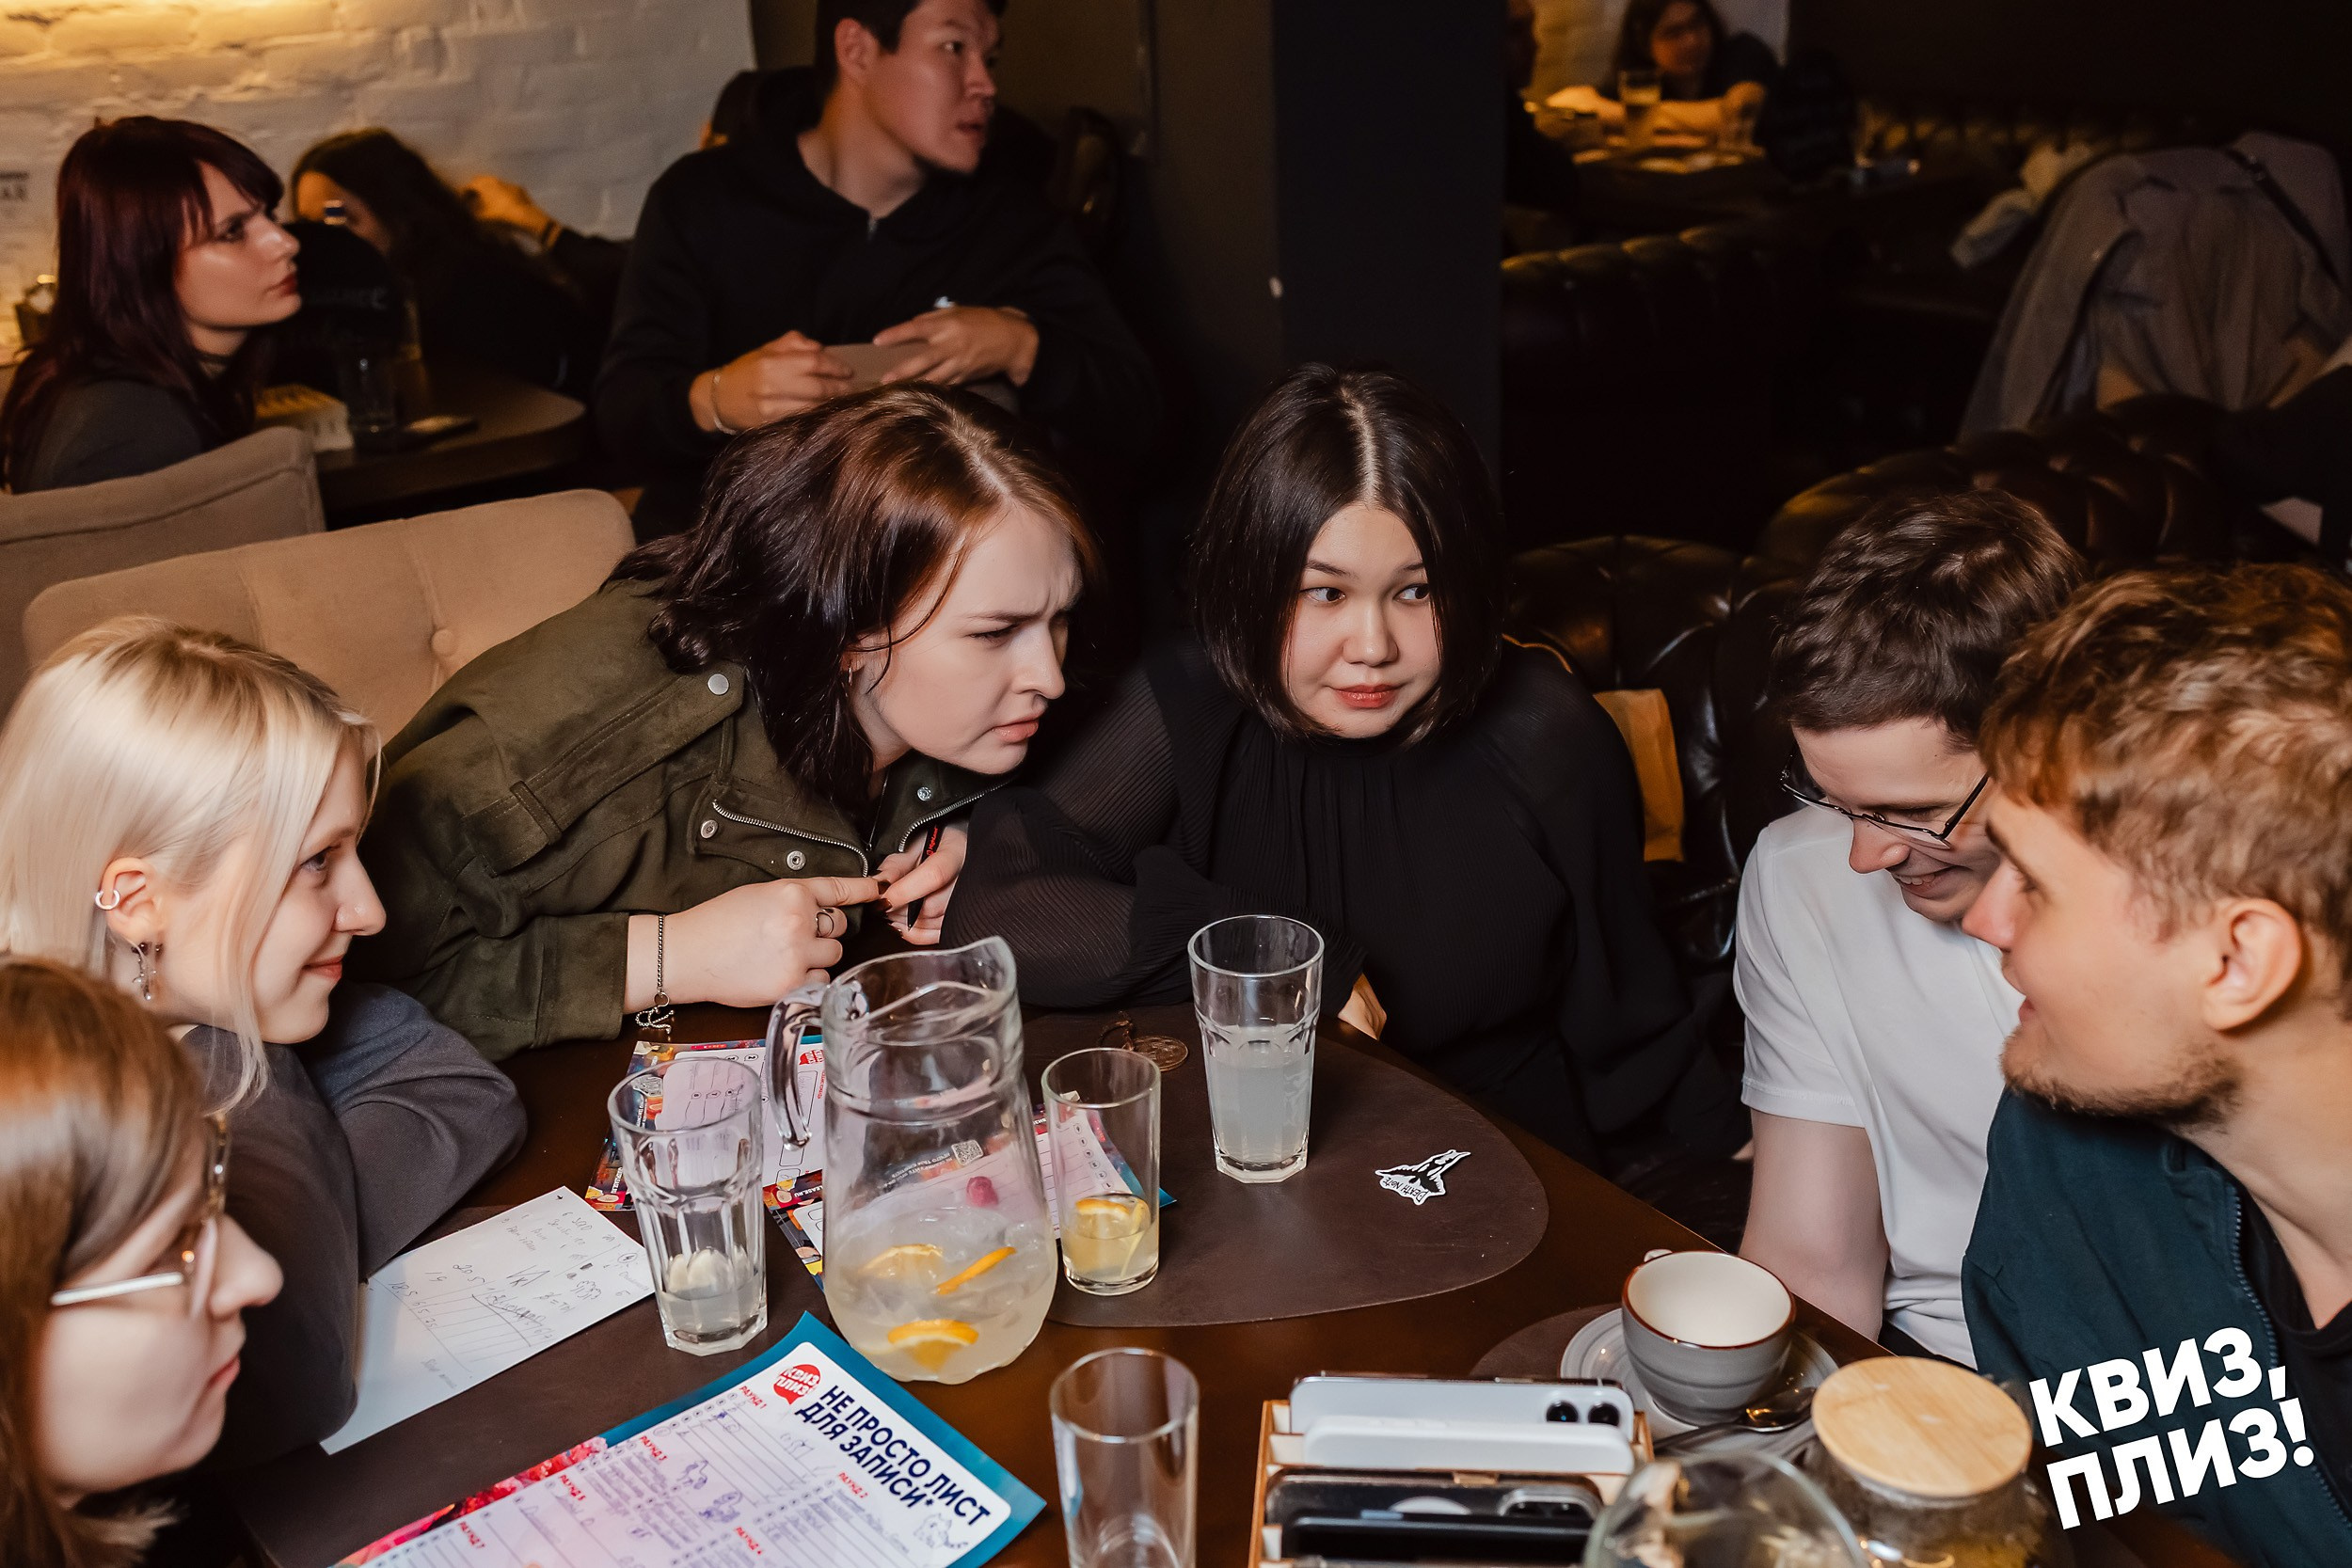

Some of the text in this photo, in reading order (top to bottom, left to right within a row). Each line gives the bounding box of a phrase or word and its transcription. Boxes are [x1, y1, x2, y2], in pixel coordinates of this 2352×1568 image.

[794, 1185, 824, 1197] LEASE.RU
[1401, 1185, 1429, 1202] DEATH
[739, 1386, 763, 1409] РАУНД
[794, 1402, 849, 1441] ДЛЯ
[640, 1434, 662, 1461] РАУНД
[819, 1385, 855, 1414] НЕ
[845, 1406, 931, 1478] ПРОСТО
[924, 1473, 991, 1526] ЛИСТ
[559, 1474, 581, 1500] РАУНД
[838, 1471, 863, 1497] РАУНД
[735, 1526, 760, 1551] РАУНД
